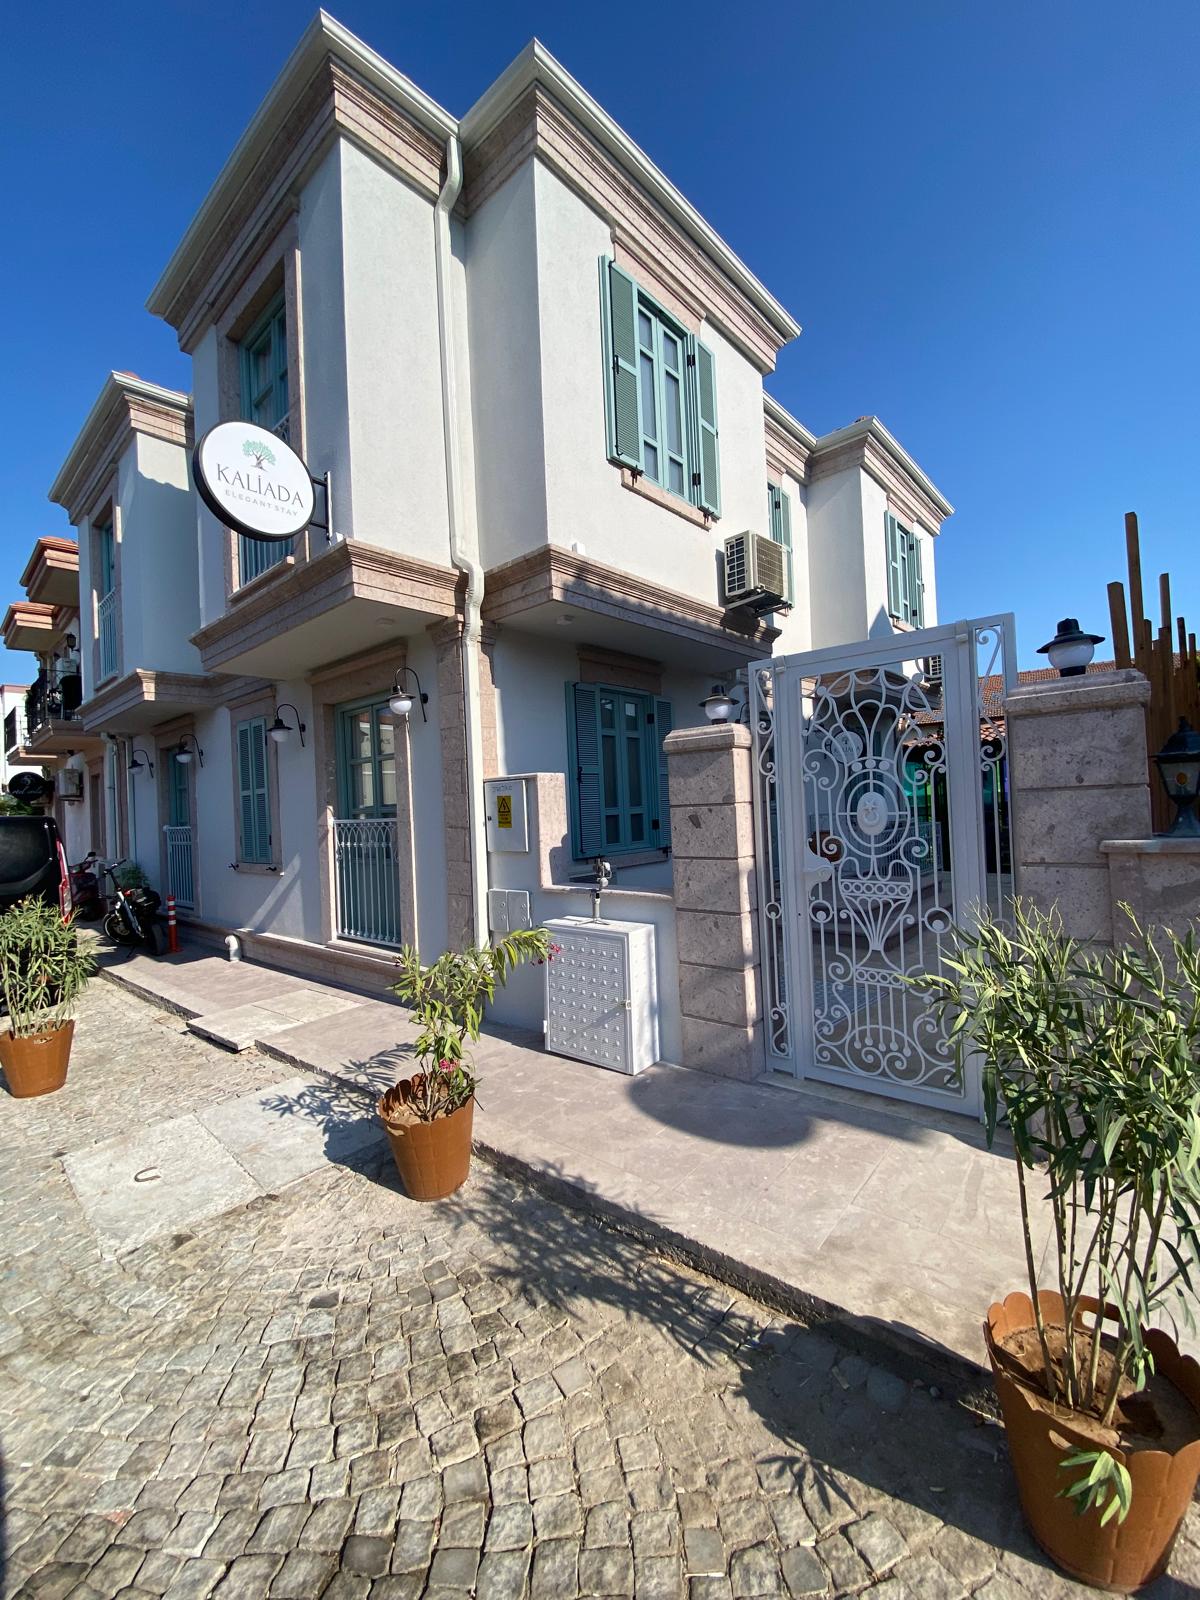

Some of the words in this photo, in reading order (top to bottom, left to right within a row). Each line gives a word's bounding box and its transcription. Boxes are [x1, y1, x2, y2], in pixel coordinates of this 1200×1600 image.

[217, 463, 304, 508] KALİADA
[225, 489, 271, 509] ELEGANT
[274, 505, 298, 517] STAY
